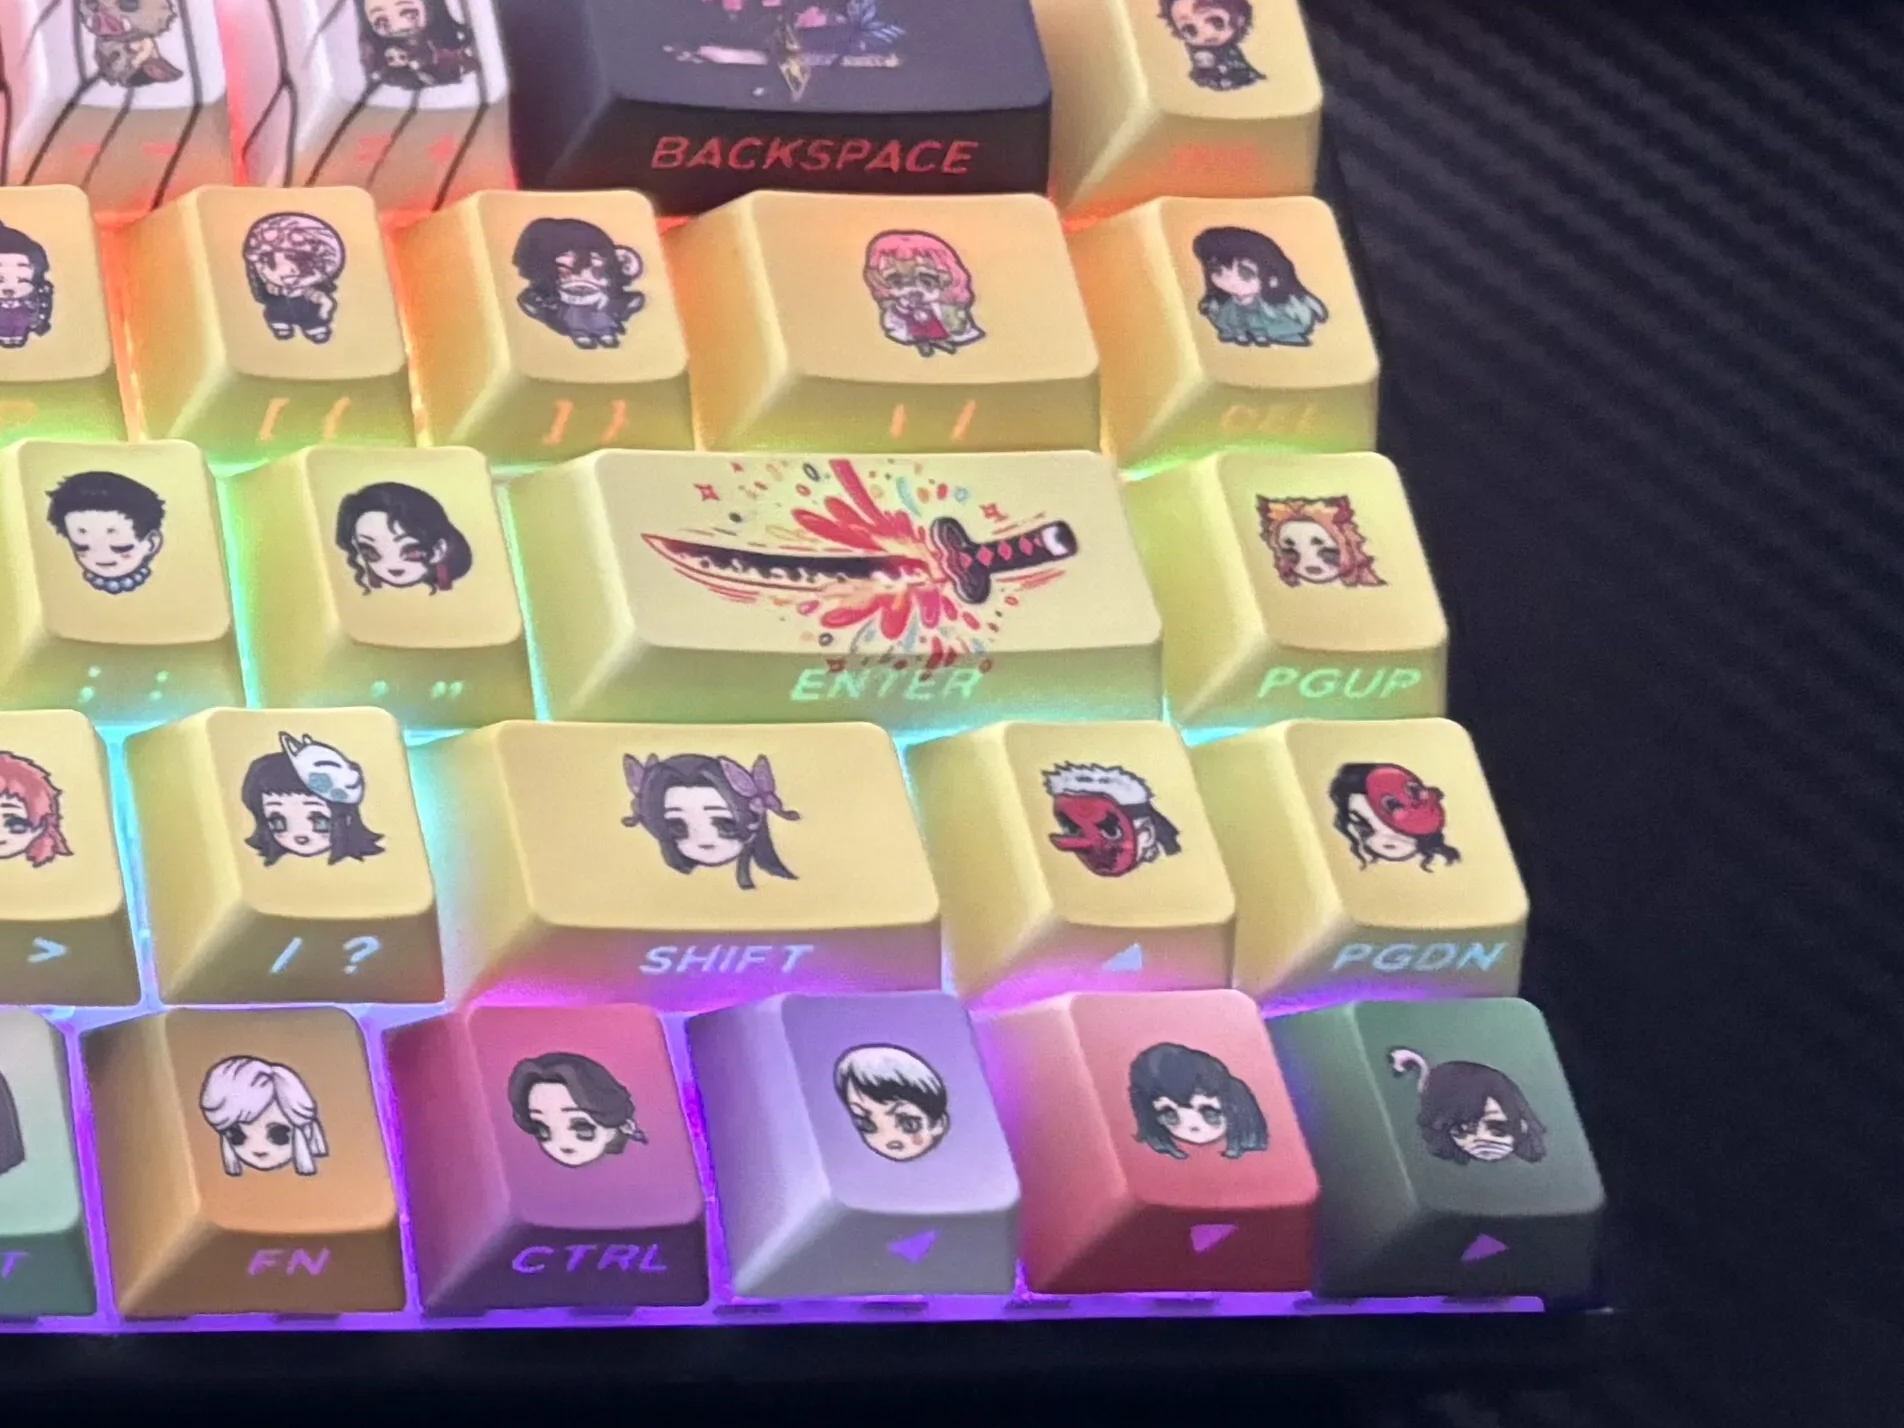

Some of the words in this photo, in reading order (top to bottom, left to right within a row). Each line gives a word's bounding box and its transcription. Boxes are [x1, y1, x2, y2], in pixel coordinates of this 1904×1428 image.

[651, 135, 980, 175] BACKSPACE
[790, 666, 985, 701] ENTER
[1257, 666, 1423, 700] PGUP
[342, 935, 382, 974] ?
[639, 944, 814, 974] SHIFT
[1332, 942, 1508, 972] PGDN
[247, 1248, 330, 1277] FN
[511, 1243, 669, 1275] CTRL
